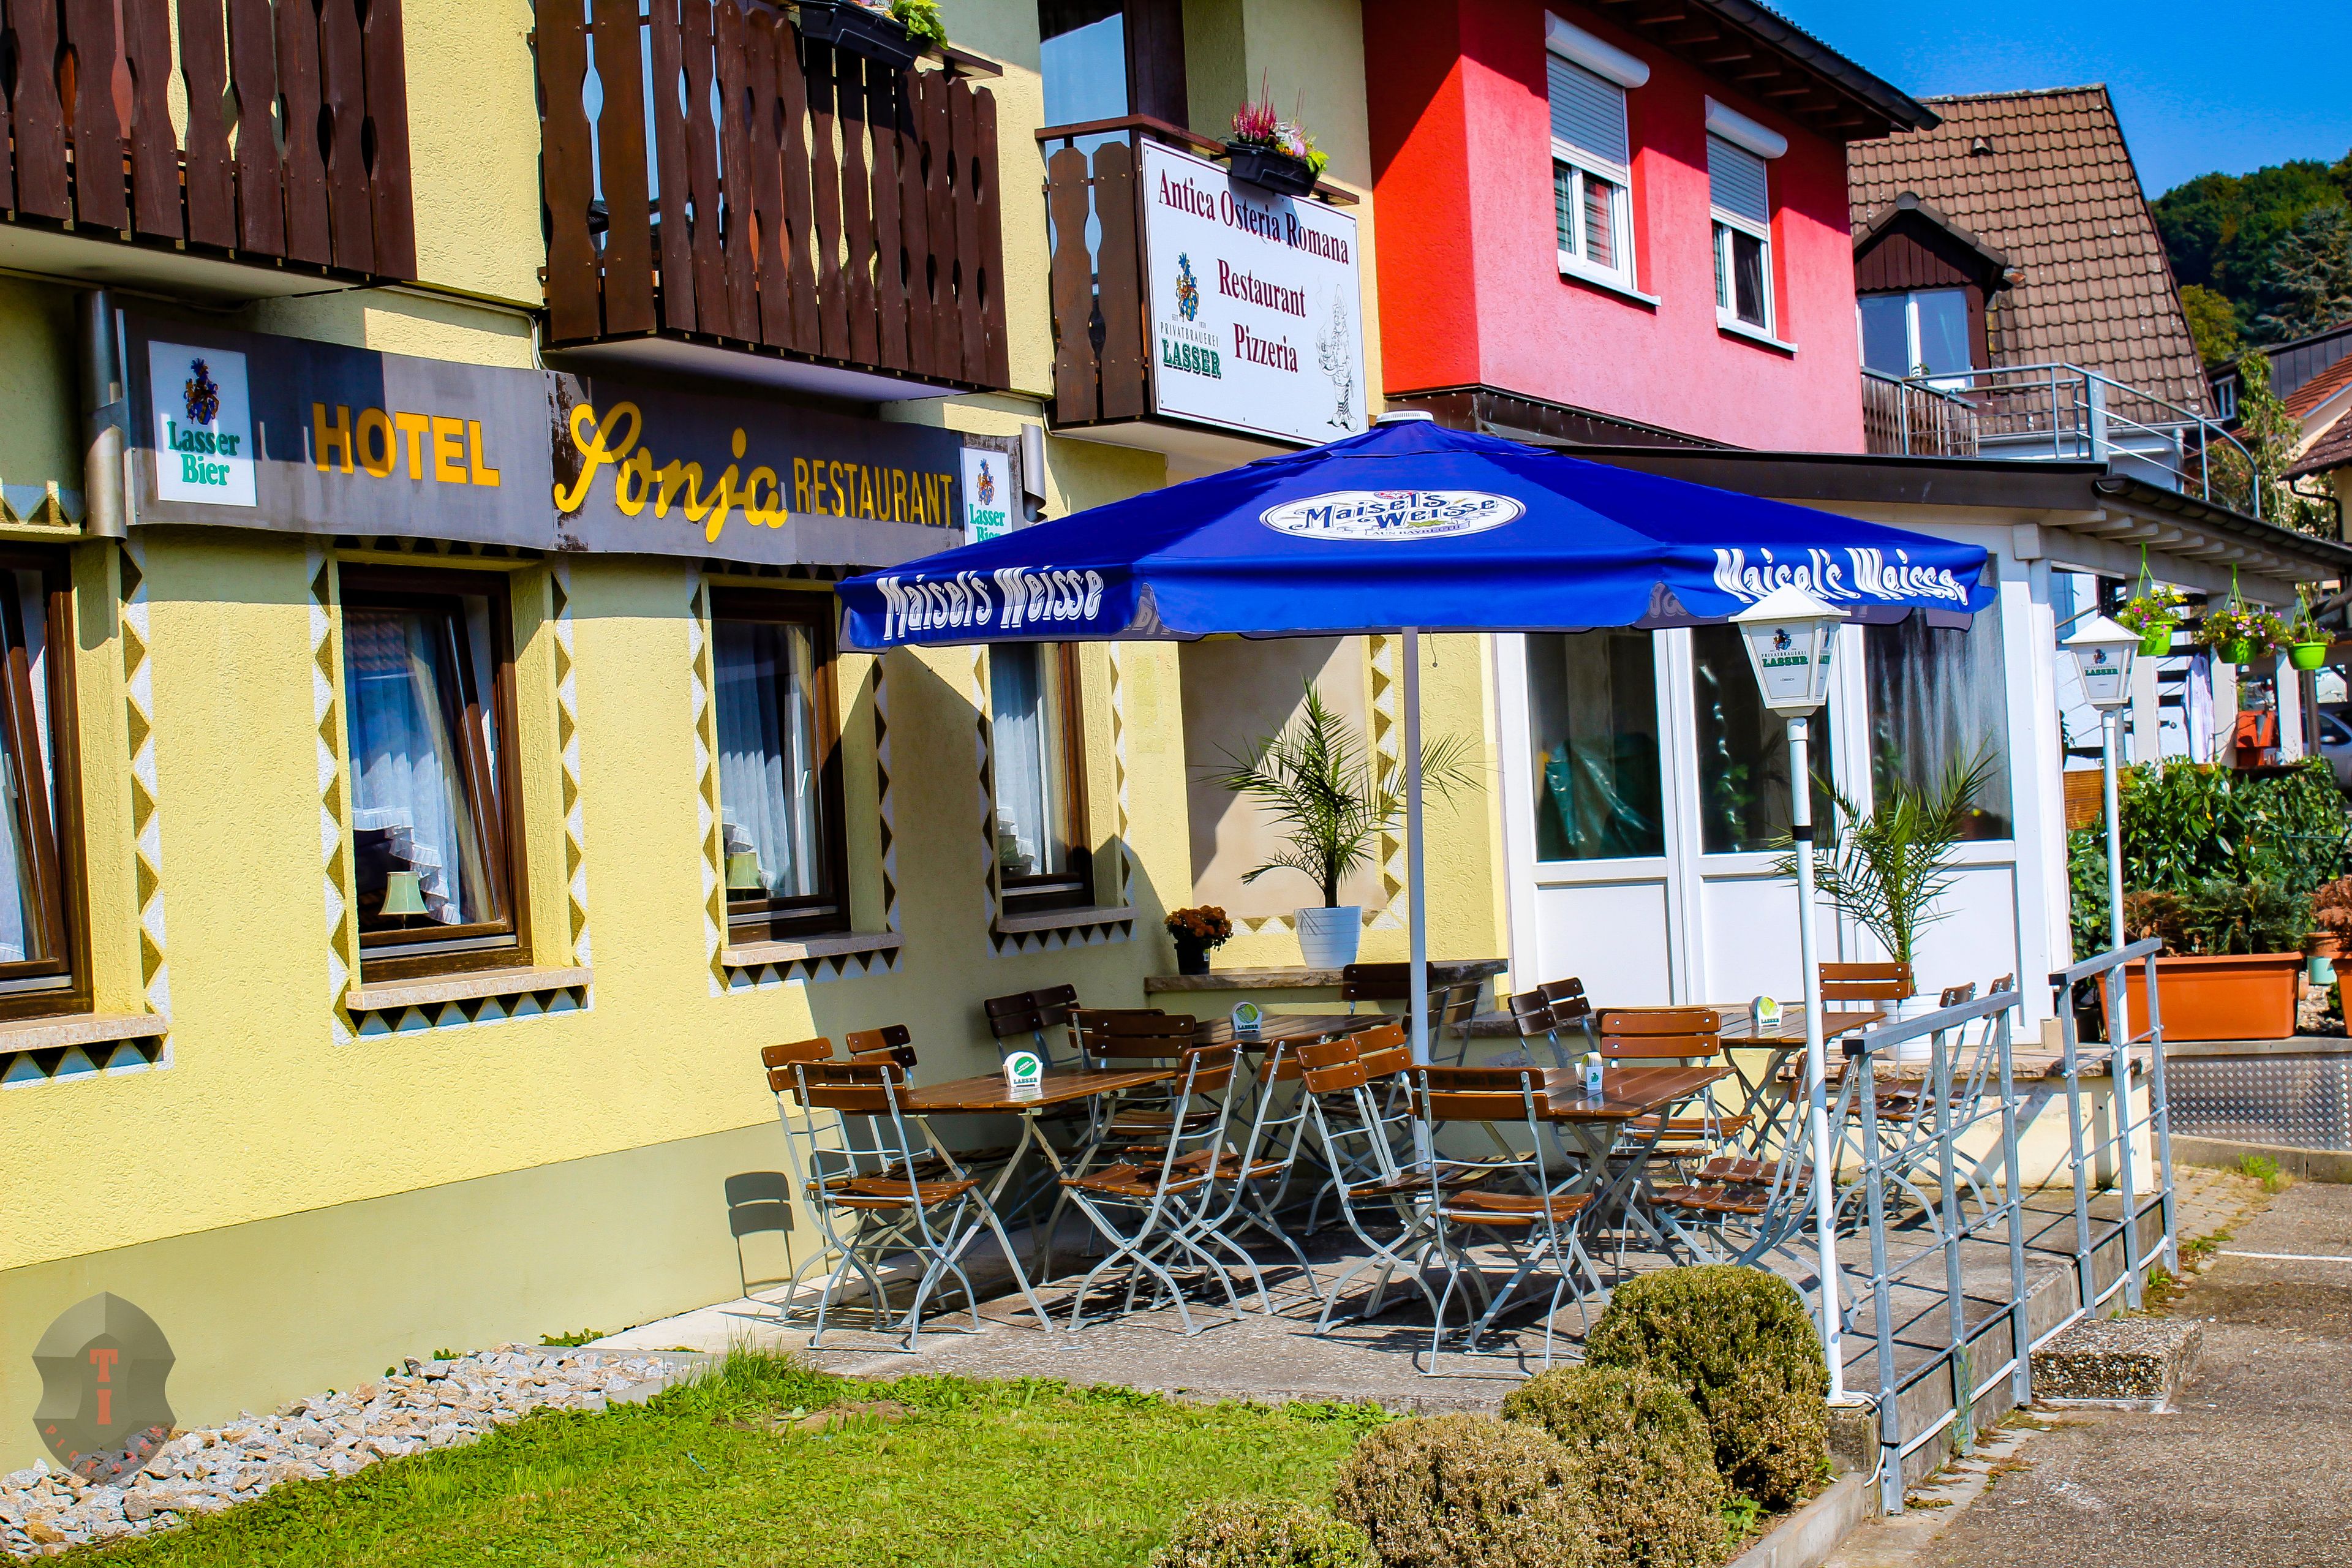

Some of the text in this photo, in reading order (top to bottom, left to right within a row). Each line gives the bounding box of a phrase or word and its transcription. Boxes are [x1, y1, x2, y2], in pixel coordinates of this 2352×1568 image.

[1158, 169, 1349, 265] Antica Osteria Romana
[1217, 258, 1306, 318] Restaurant
[1160, 322, 1218, 347] PRIVATBRAUEREI
[1233, 323, 1298, 373] Pizzeria
[1161, 337, 1221, 380] LASSER
[167, 421, 240, 456] Lasser
[312, 402, 500, 486] HOTEL
[181, 453, 230, 486] Bier
[554, 401, 953, 543] Sonja RESTAURANT
[968, 503, 1006, 527] Lasser
[1288, 491, 1450, 530] Maisel's
[1357, 498, 1500, 530] Weisse
[1844, 548, 1969, 606] Weisse
[876, 571, 992, 641] Maisel's
[993, 565, 1103, 629] Weisse
[1762, 656, 1809, 668] LASSER
